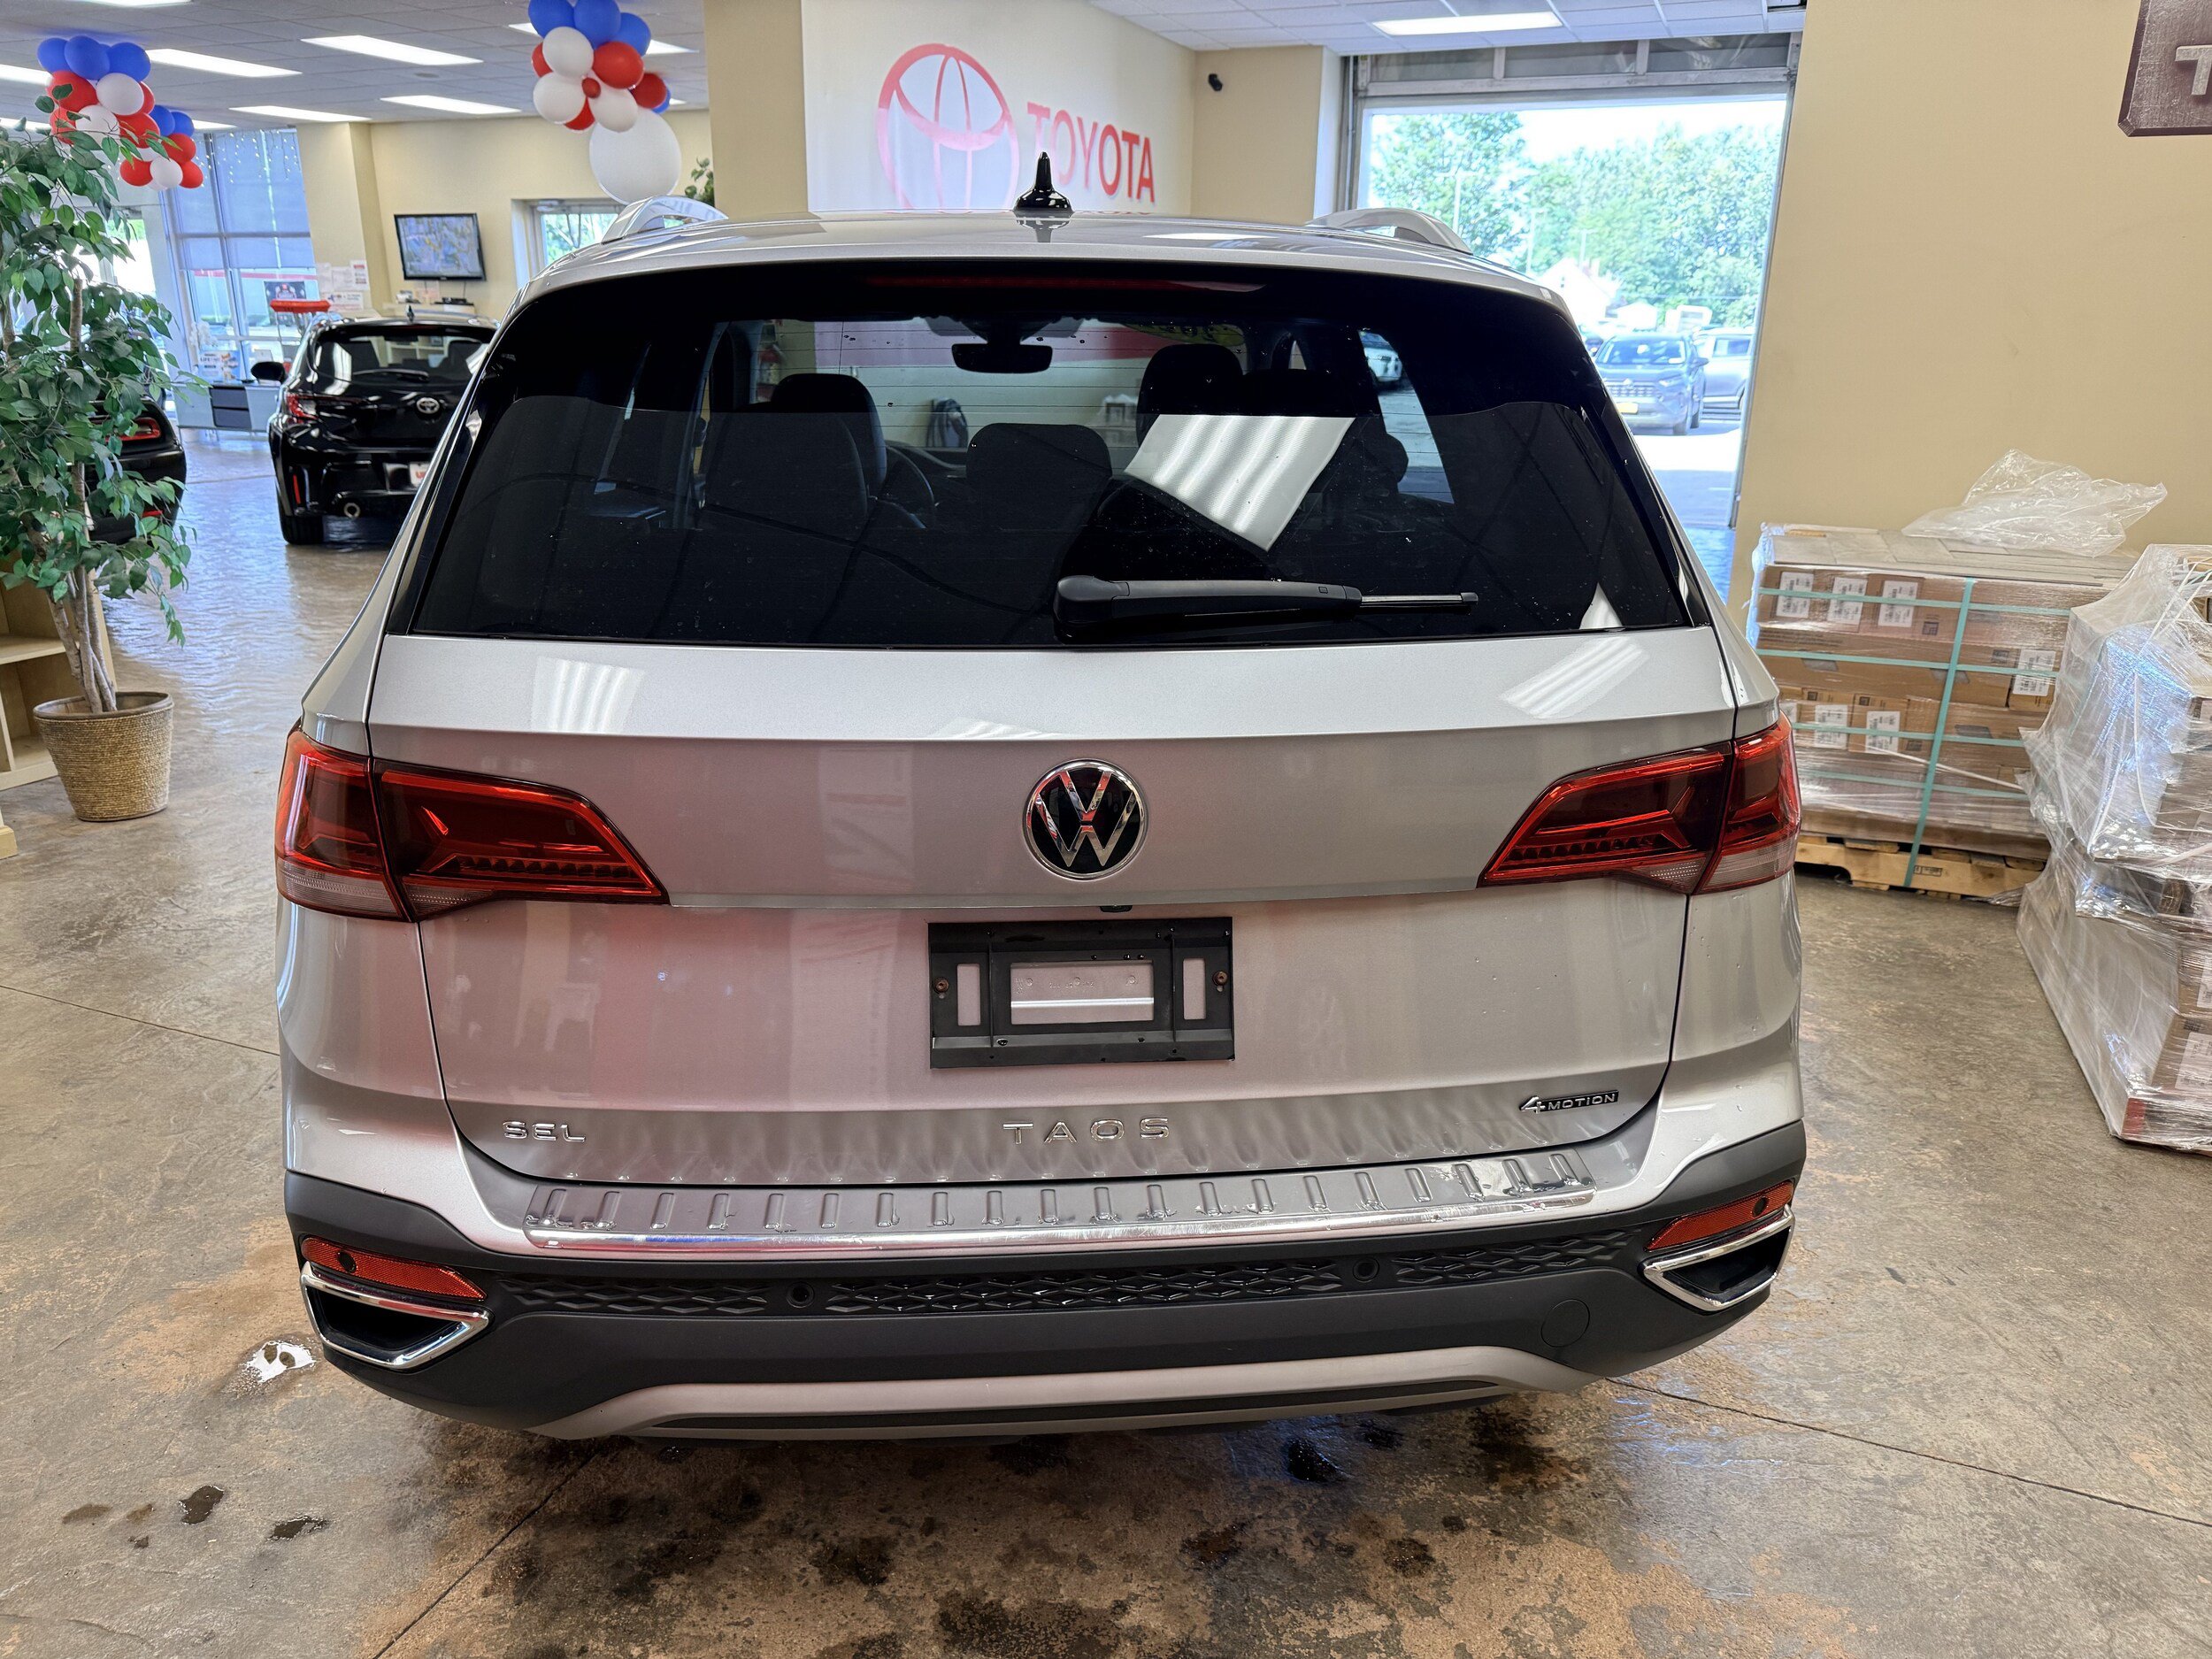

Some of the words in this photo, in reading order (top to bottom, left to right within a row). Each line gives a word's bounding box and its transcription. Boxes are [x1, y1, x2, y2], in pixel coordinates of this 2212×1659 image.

[1027, 101, 1155, 203] TOYOTA
[503, 1121, 586, 1142] SEL
[1002, 1118, 1170, 1145] TAOS
